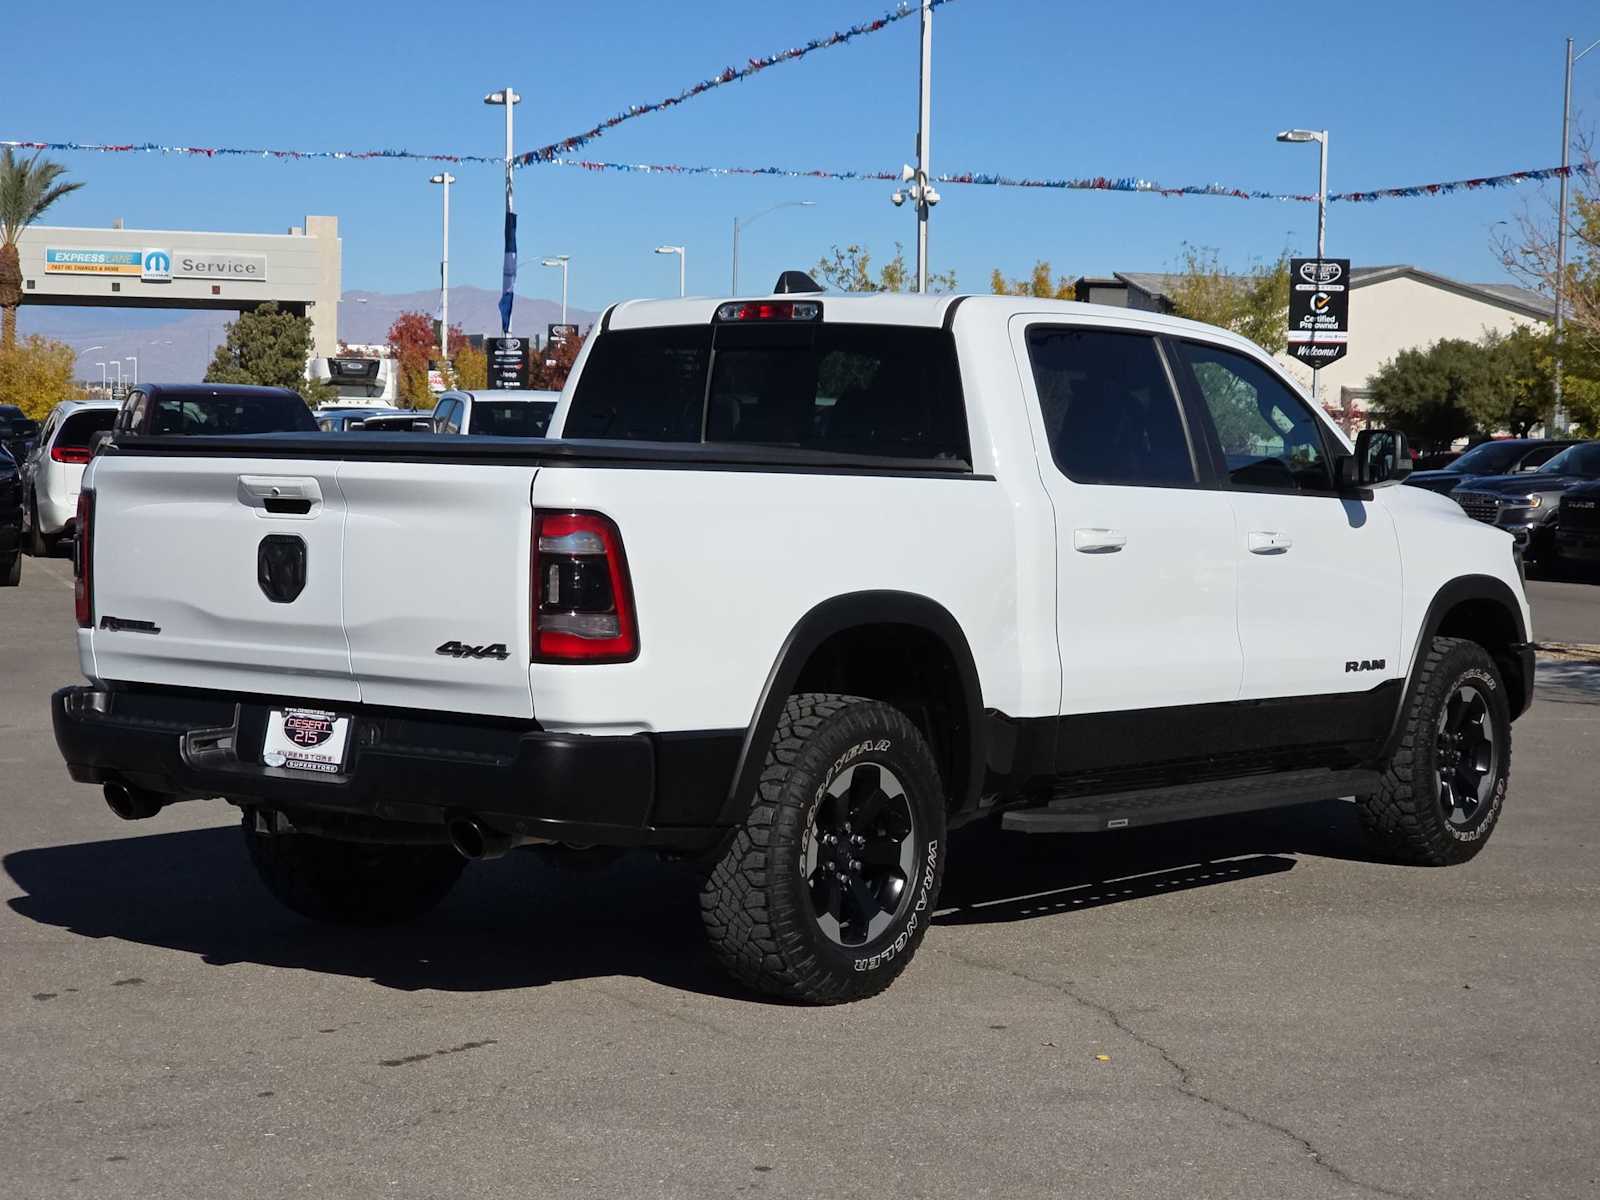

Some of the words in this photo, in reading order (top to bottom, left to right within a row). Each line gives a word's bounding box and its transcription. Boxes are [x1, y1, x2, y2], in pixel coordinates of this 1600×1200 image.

[55, 252, 105, 263] EXPRESS
[182, 258, 257, 274] Service
[1304, 315, 1336, 323] Cetified
[1297, 345, 1340, 357] Welcome!
[434, 640, 512, 660] 4x4
[1345, 659, 1386, 673] RAM
[288, 718, 330, 730] DESERT
[294, 730, 318, 743] 215
[289, 760, 336, 772] SUPERSTORE
[854, 840, 938, 972] WRANGLER
